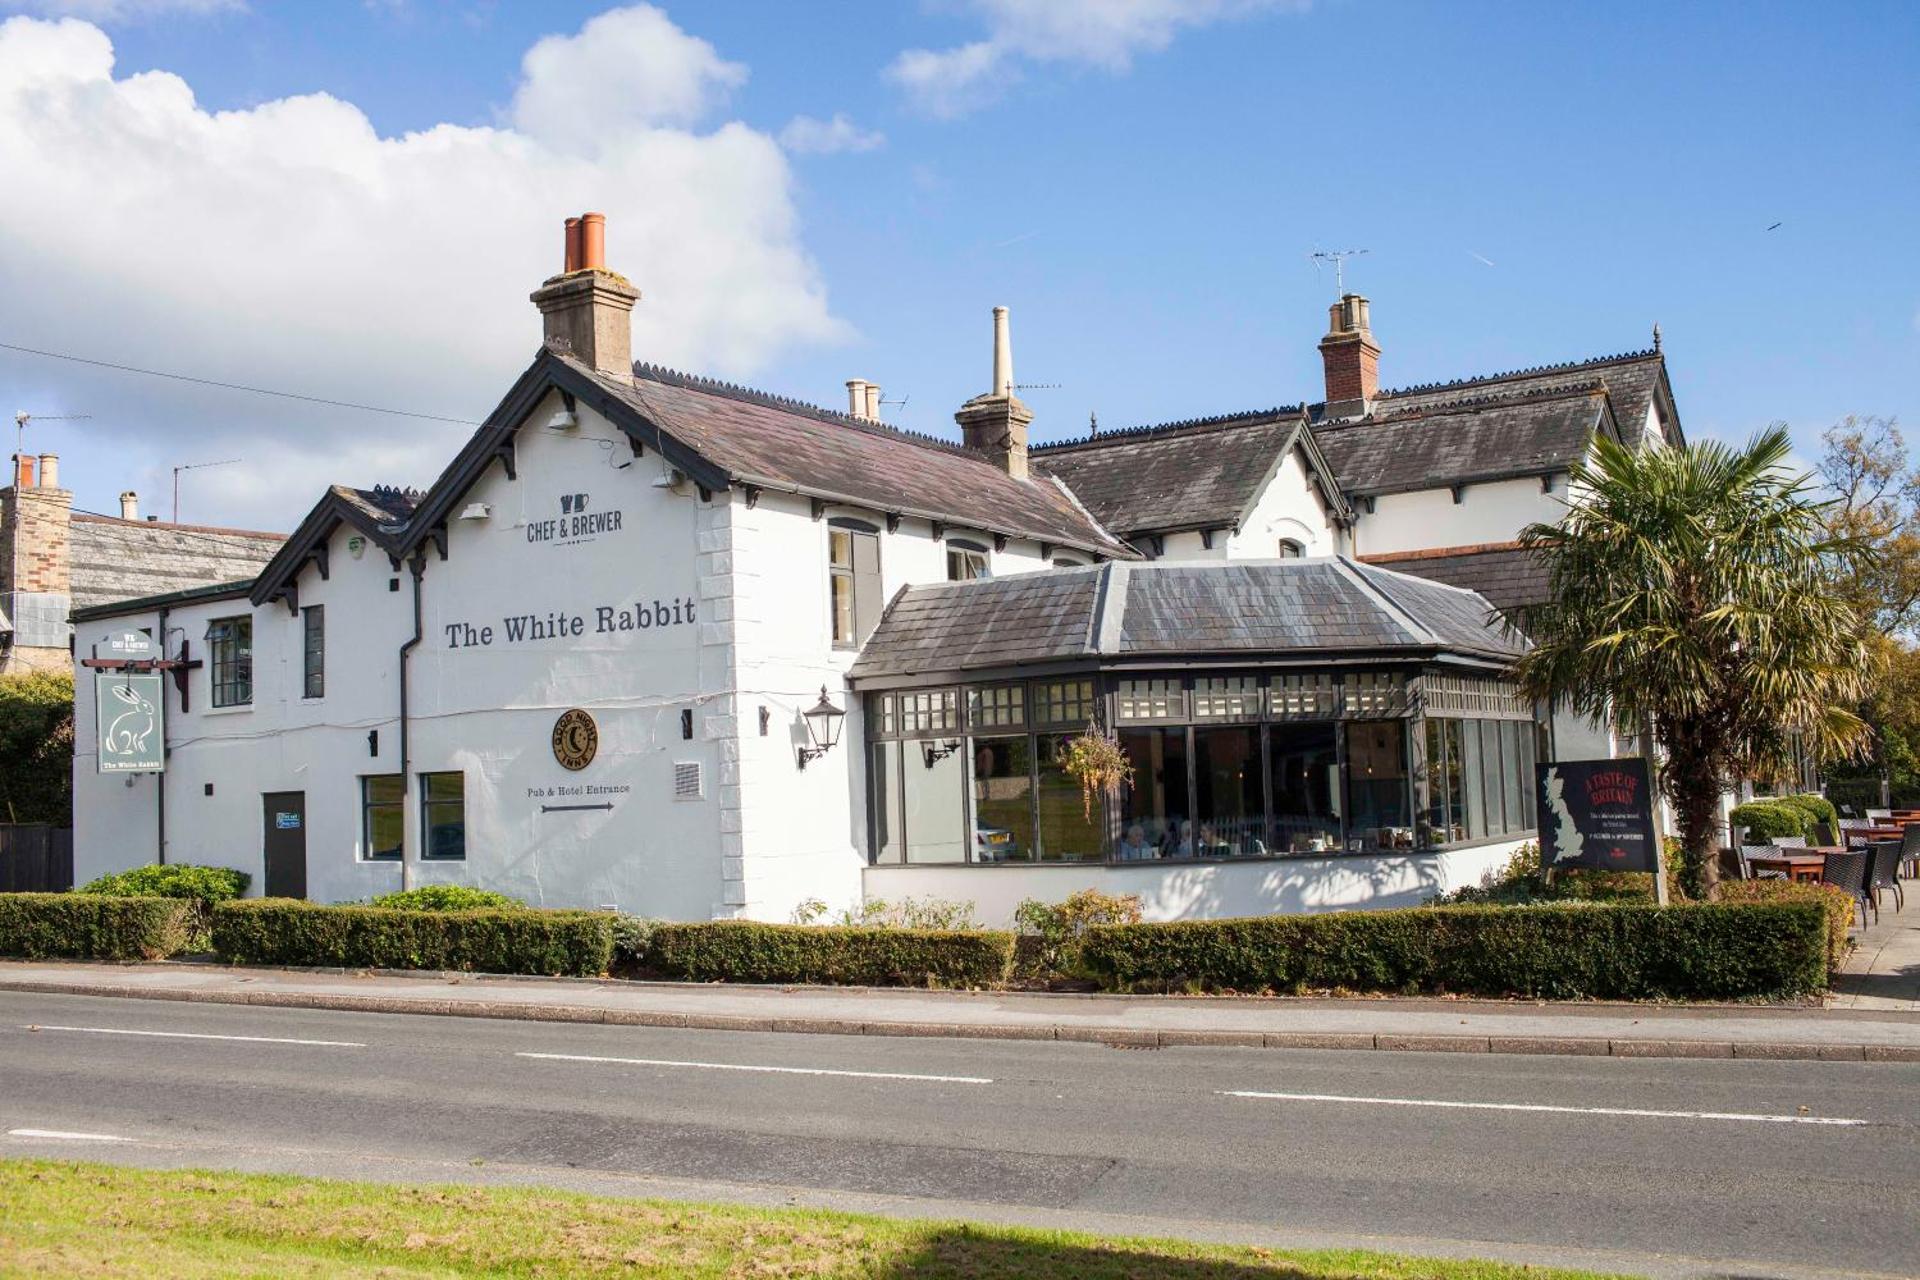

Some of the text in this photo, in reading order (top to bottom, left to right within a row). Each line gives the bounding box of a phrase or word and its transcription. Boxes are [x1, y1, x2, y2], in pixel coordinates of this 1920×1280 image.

[527, 510, 622, 543] CHEF & BREWER
[445, 597, 696, 649] The White Rabbit
[556, 712, 597, 746] GOOD NIGHT
[103, 761, 117, 769] The
[561, 756, 589, 768] INNS
[1591, 771, 1624, 790] TASTE
[1624, 775, 1639, 790] OF
[527, 784, 631, 798] Pub & Hotel Entrance
[1591, 788, 1633, 806] BRITAIN
